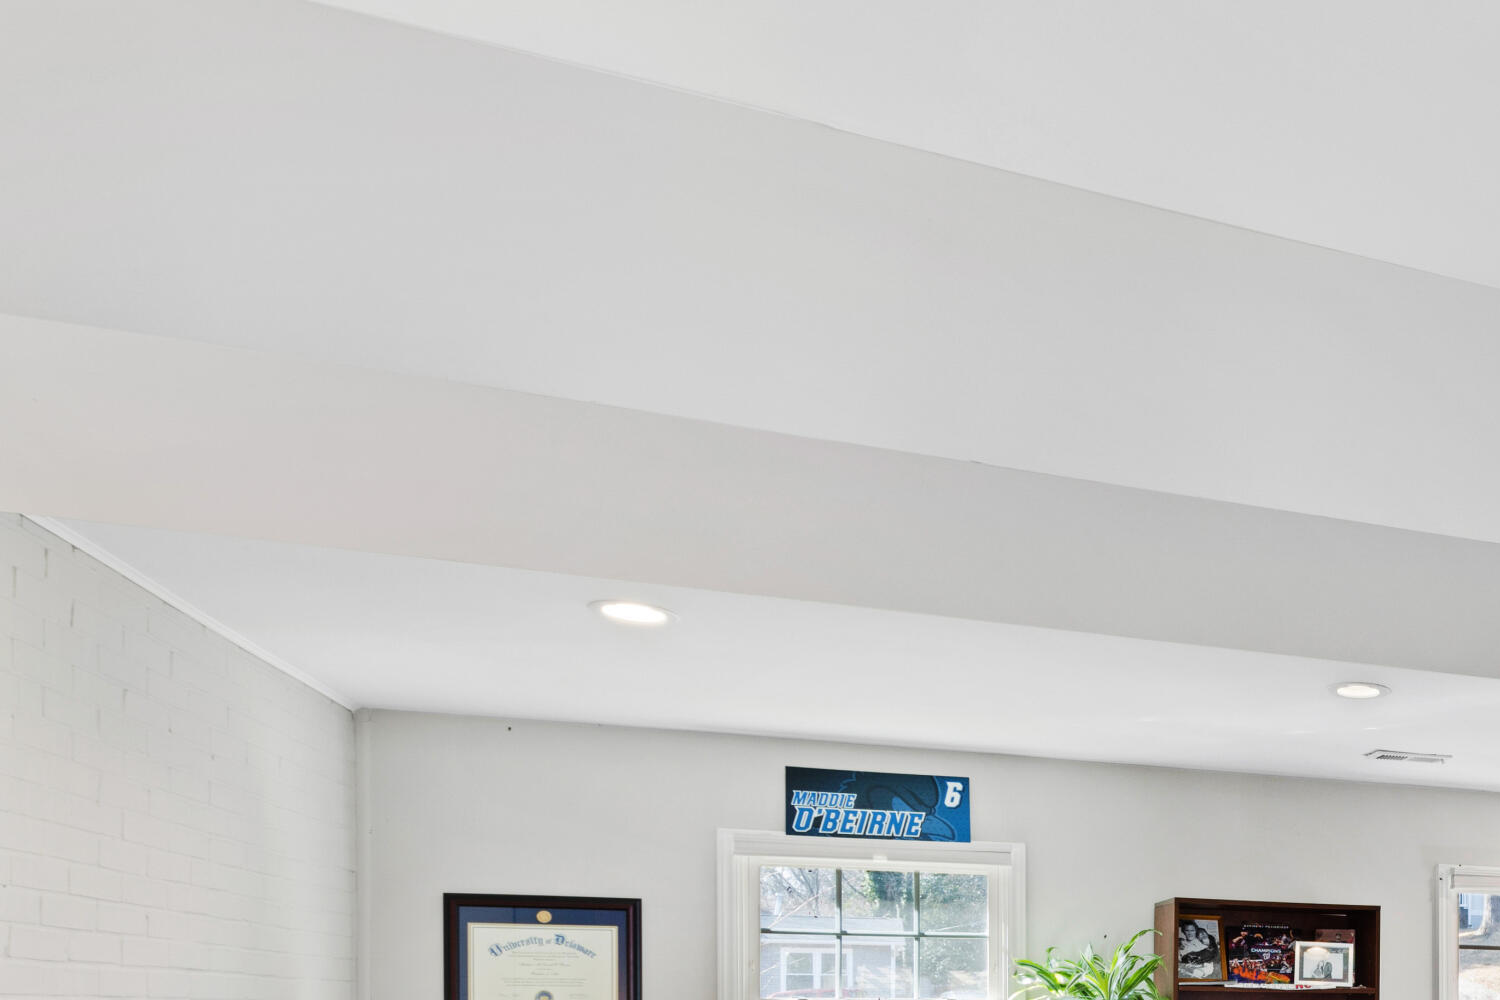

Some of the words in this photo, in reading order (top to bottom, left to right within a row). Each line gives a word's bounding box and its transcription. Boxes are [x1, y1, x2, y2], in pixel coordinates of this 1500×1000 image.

[791, 790, 857, 808] MADDIE
[944, 781, 963, 808] 6
[792, 805, 926, 838] O'BEIRNE
[488, 936, 544, 957] University
[554, 933, 597, 958] Delaware
